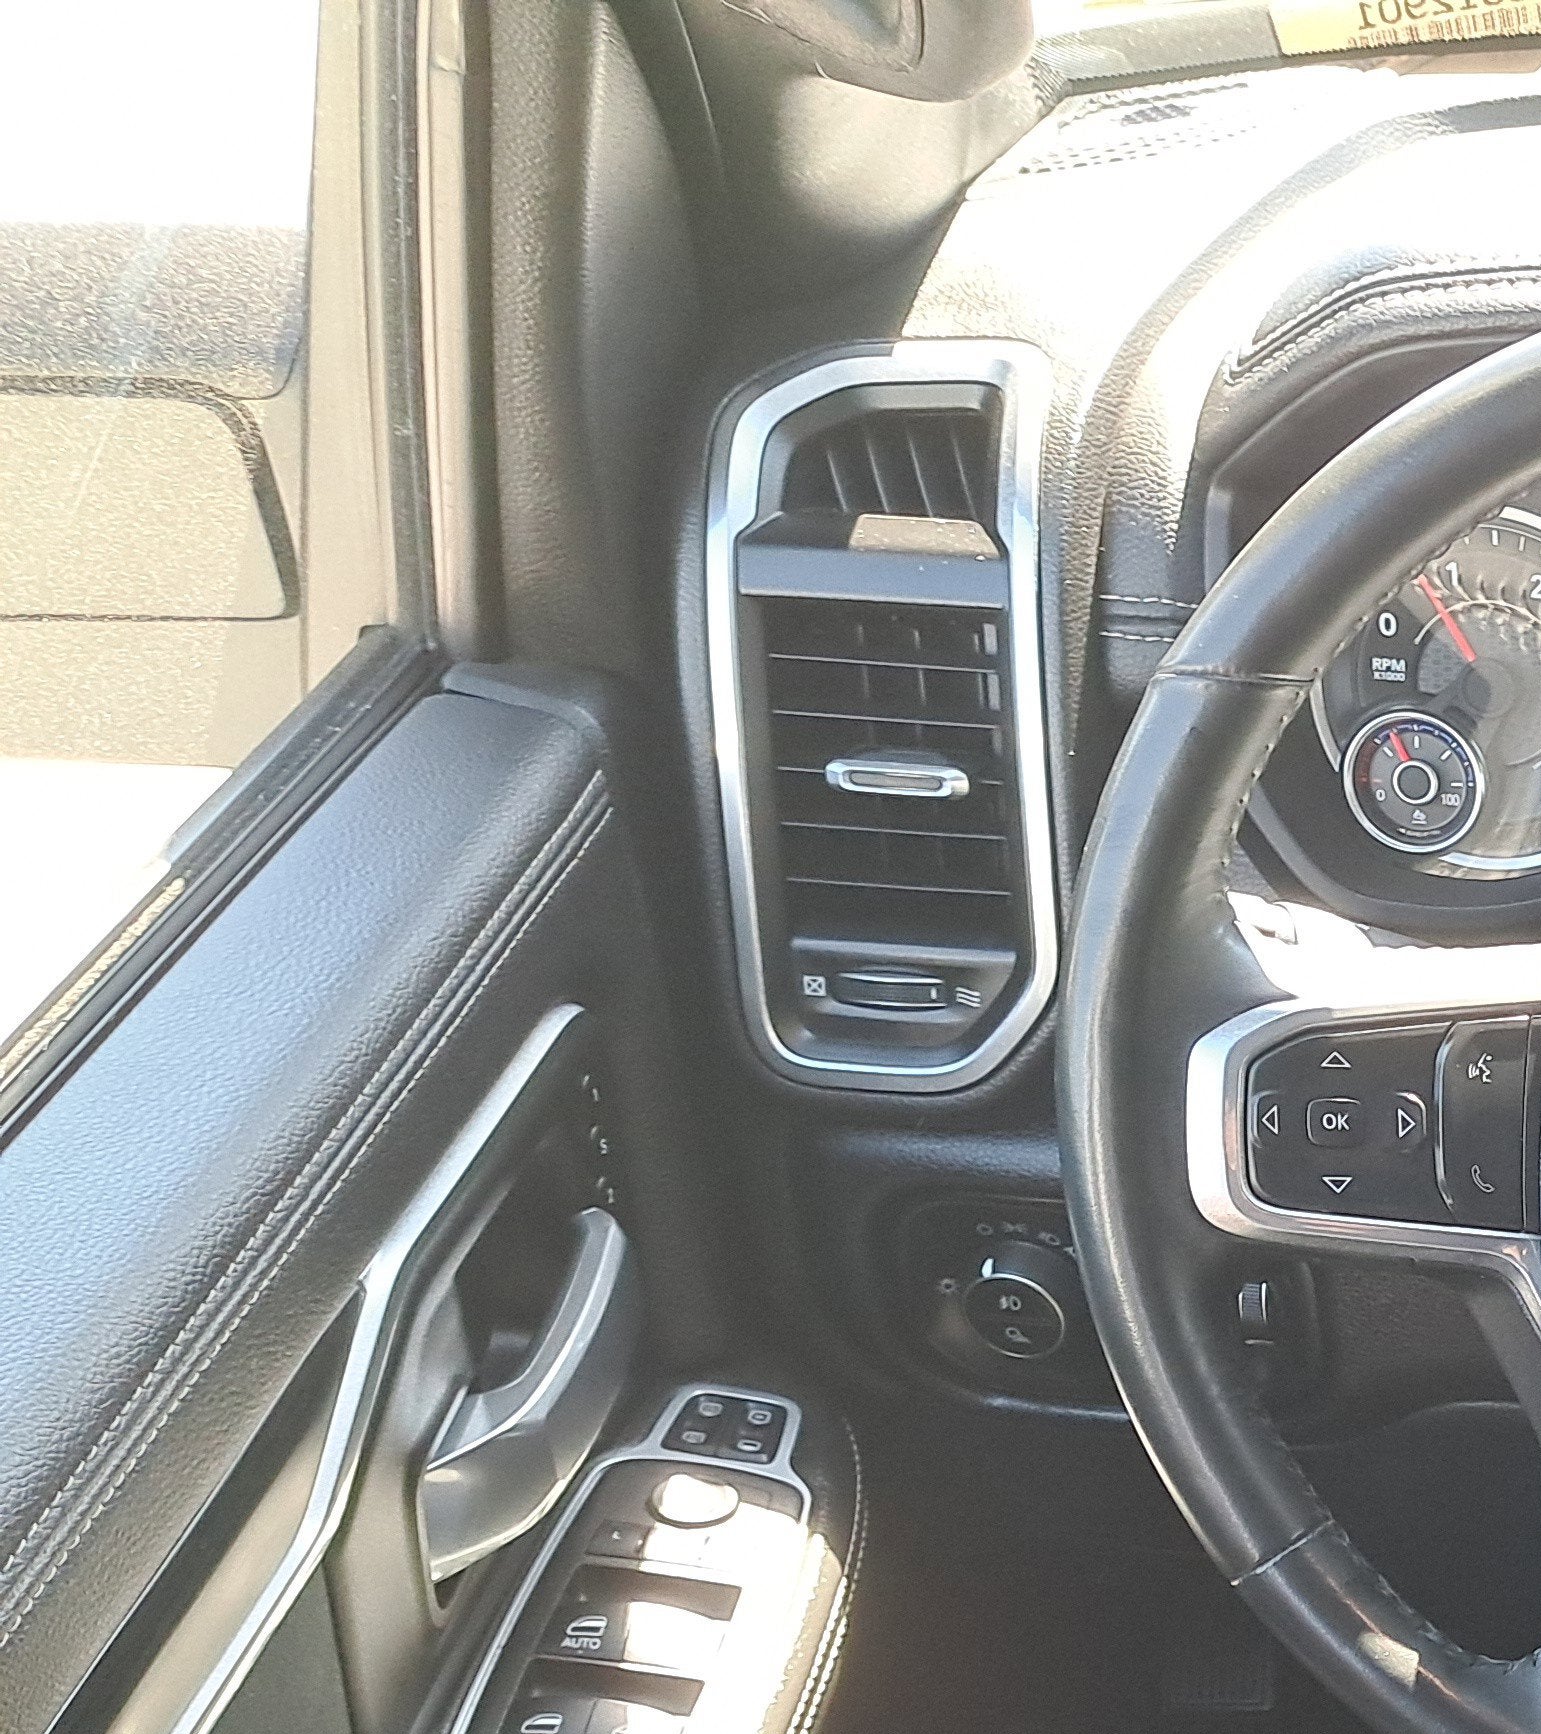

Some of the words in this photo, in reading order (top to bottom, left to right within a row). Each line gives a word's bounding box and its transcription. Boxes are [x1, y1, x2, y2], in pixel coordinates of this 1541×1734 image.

[1445, 561, 1460, 587] 1
[1377, 612, 1398, 637] 0
[1371, 657, 1406, 672] RPM
[1375, 789, 1386, 801] 0
[1440, 793, 1461, 807] 100
[1322, 1113, 1350, 1131] OK
[562, 1636, 600, 1650] AUTO
